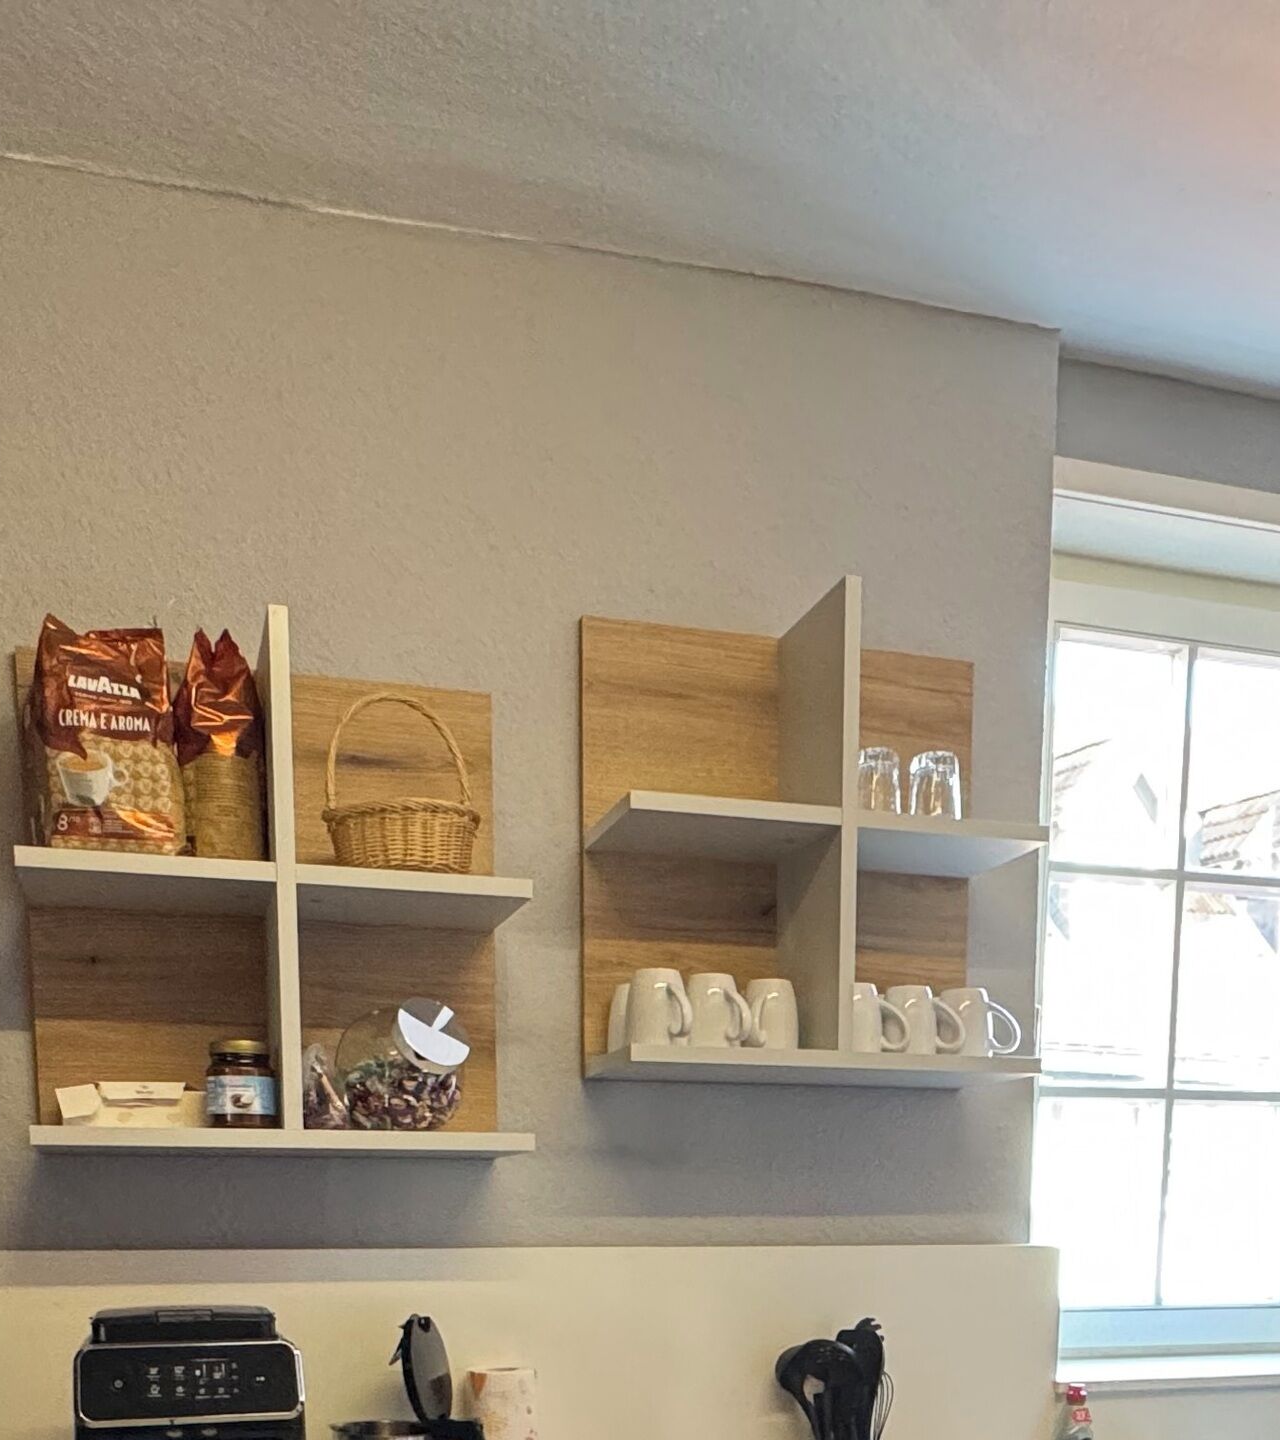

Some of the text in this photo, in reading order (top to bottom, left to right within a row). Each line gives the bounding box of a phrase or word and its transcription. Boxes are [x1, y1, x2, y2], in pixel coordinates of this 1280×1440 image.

[68, 675, 141, 700] LAVAZZA
[59, 708, 151, 732] CREMA E AROMA
